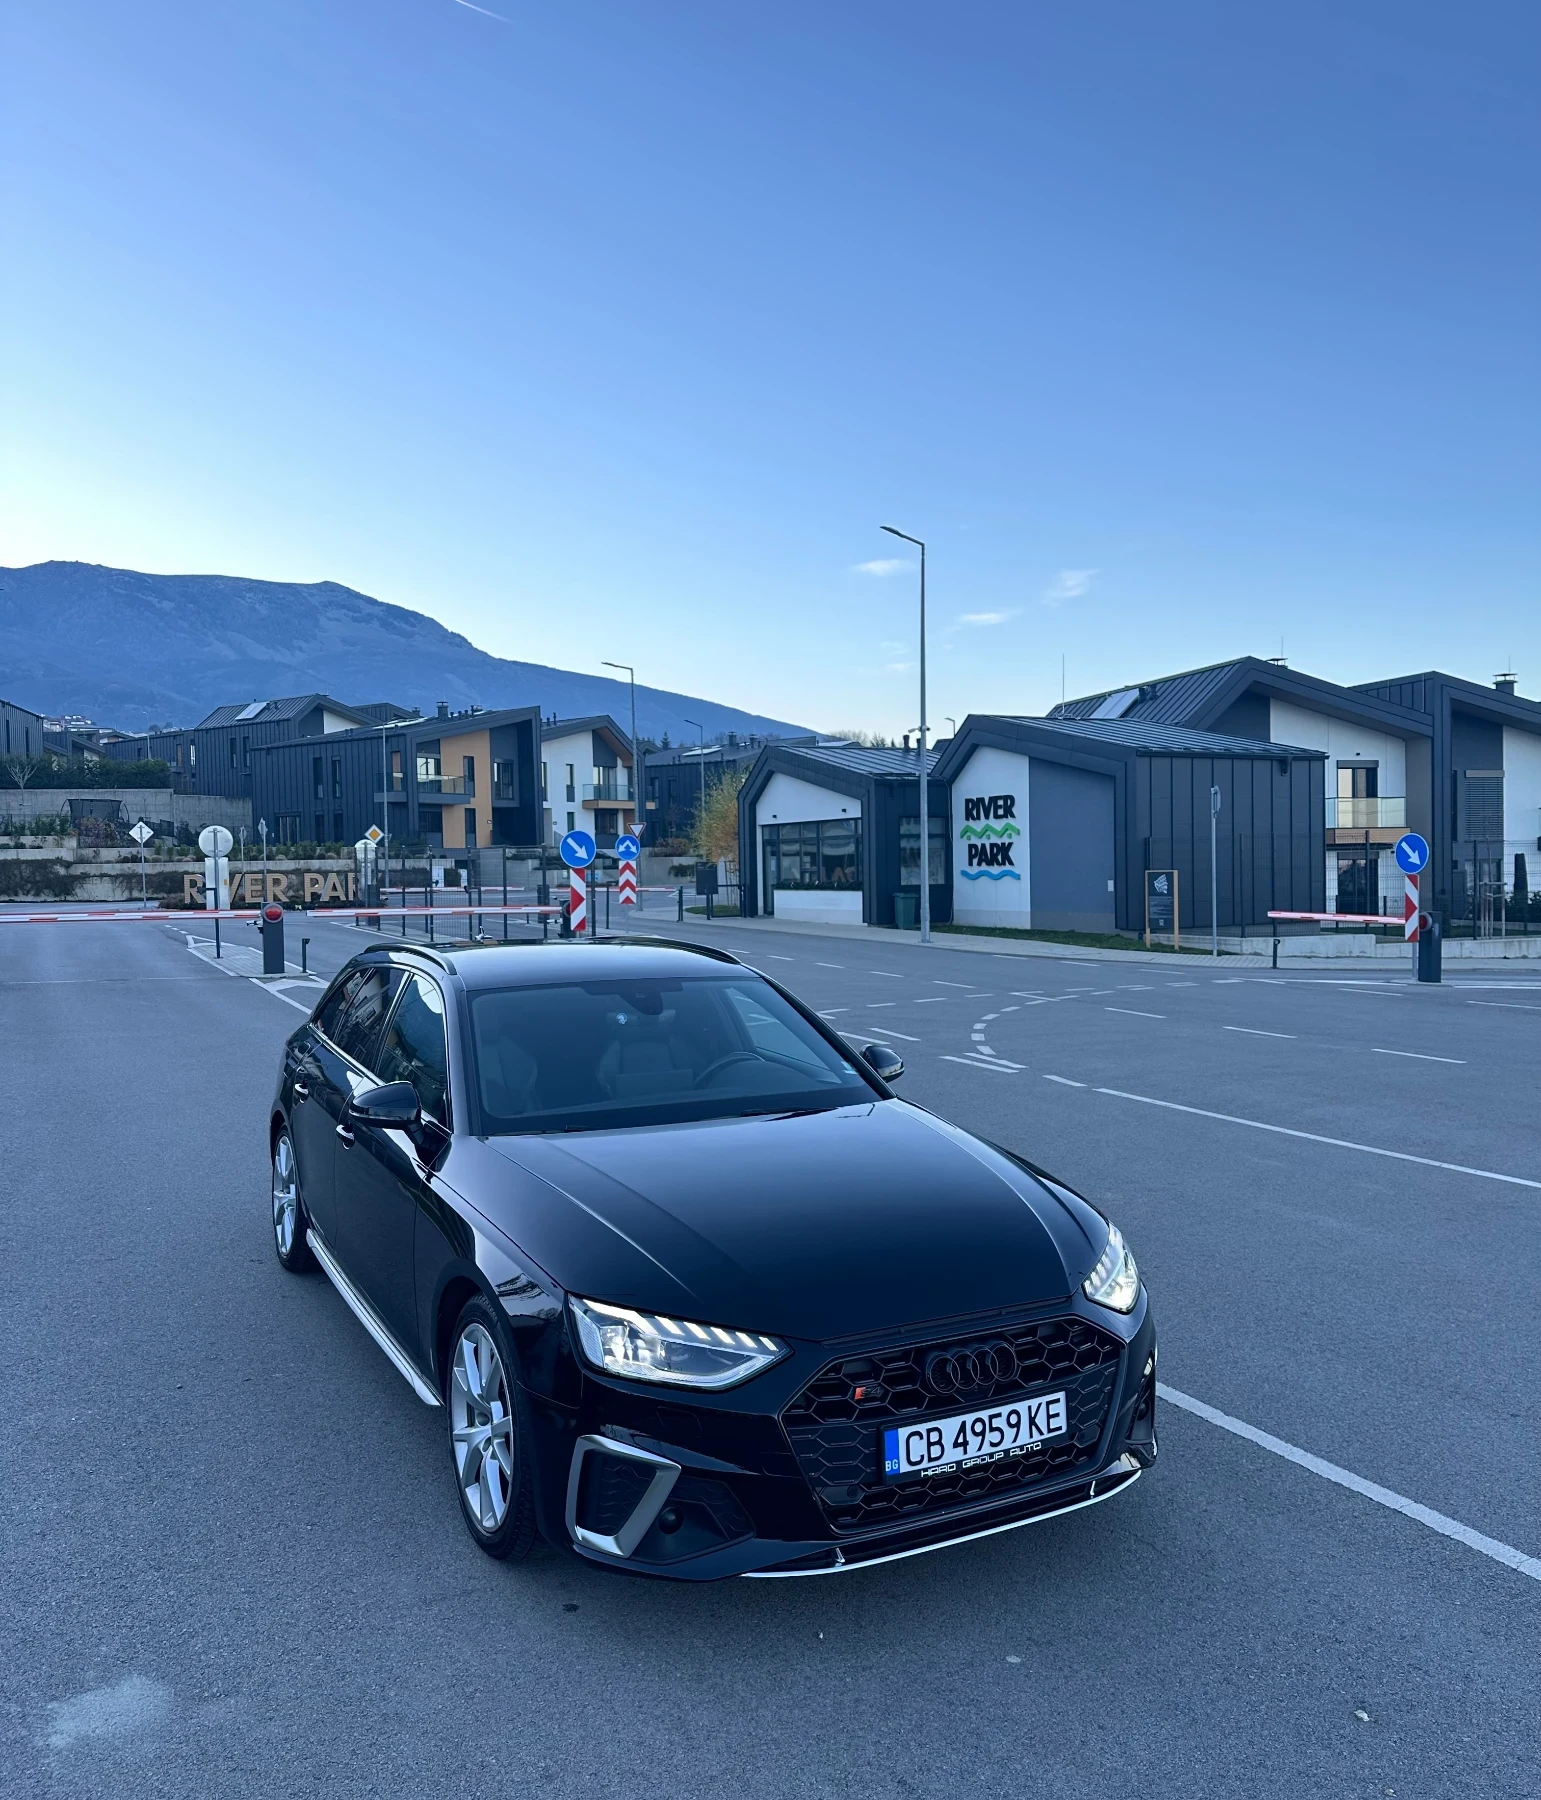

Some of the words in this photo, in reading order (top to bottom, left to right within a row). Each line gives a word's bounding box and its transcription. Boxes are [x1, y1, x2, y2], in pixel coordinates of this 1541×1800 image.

[964, 794, 1016, 821] RIVER
[968, 842, 1015, 867] PARK
[183, 873, 290, 903] RVER
[303, 872, 383, 902] PAR
[905, 1426, 945, 1467] CB
[952, 1409, 1022, 1456] 4959
[1027, 1397, 1063, 1439] KE
[885, 1459, 899, 1472] BG
[920, 1463, 957, 1478] HARD
[962, 1451, 1005, 1469] GROUP
[1009, 1441, 1042, 1457] AUTO
